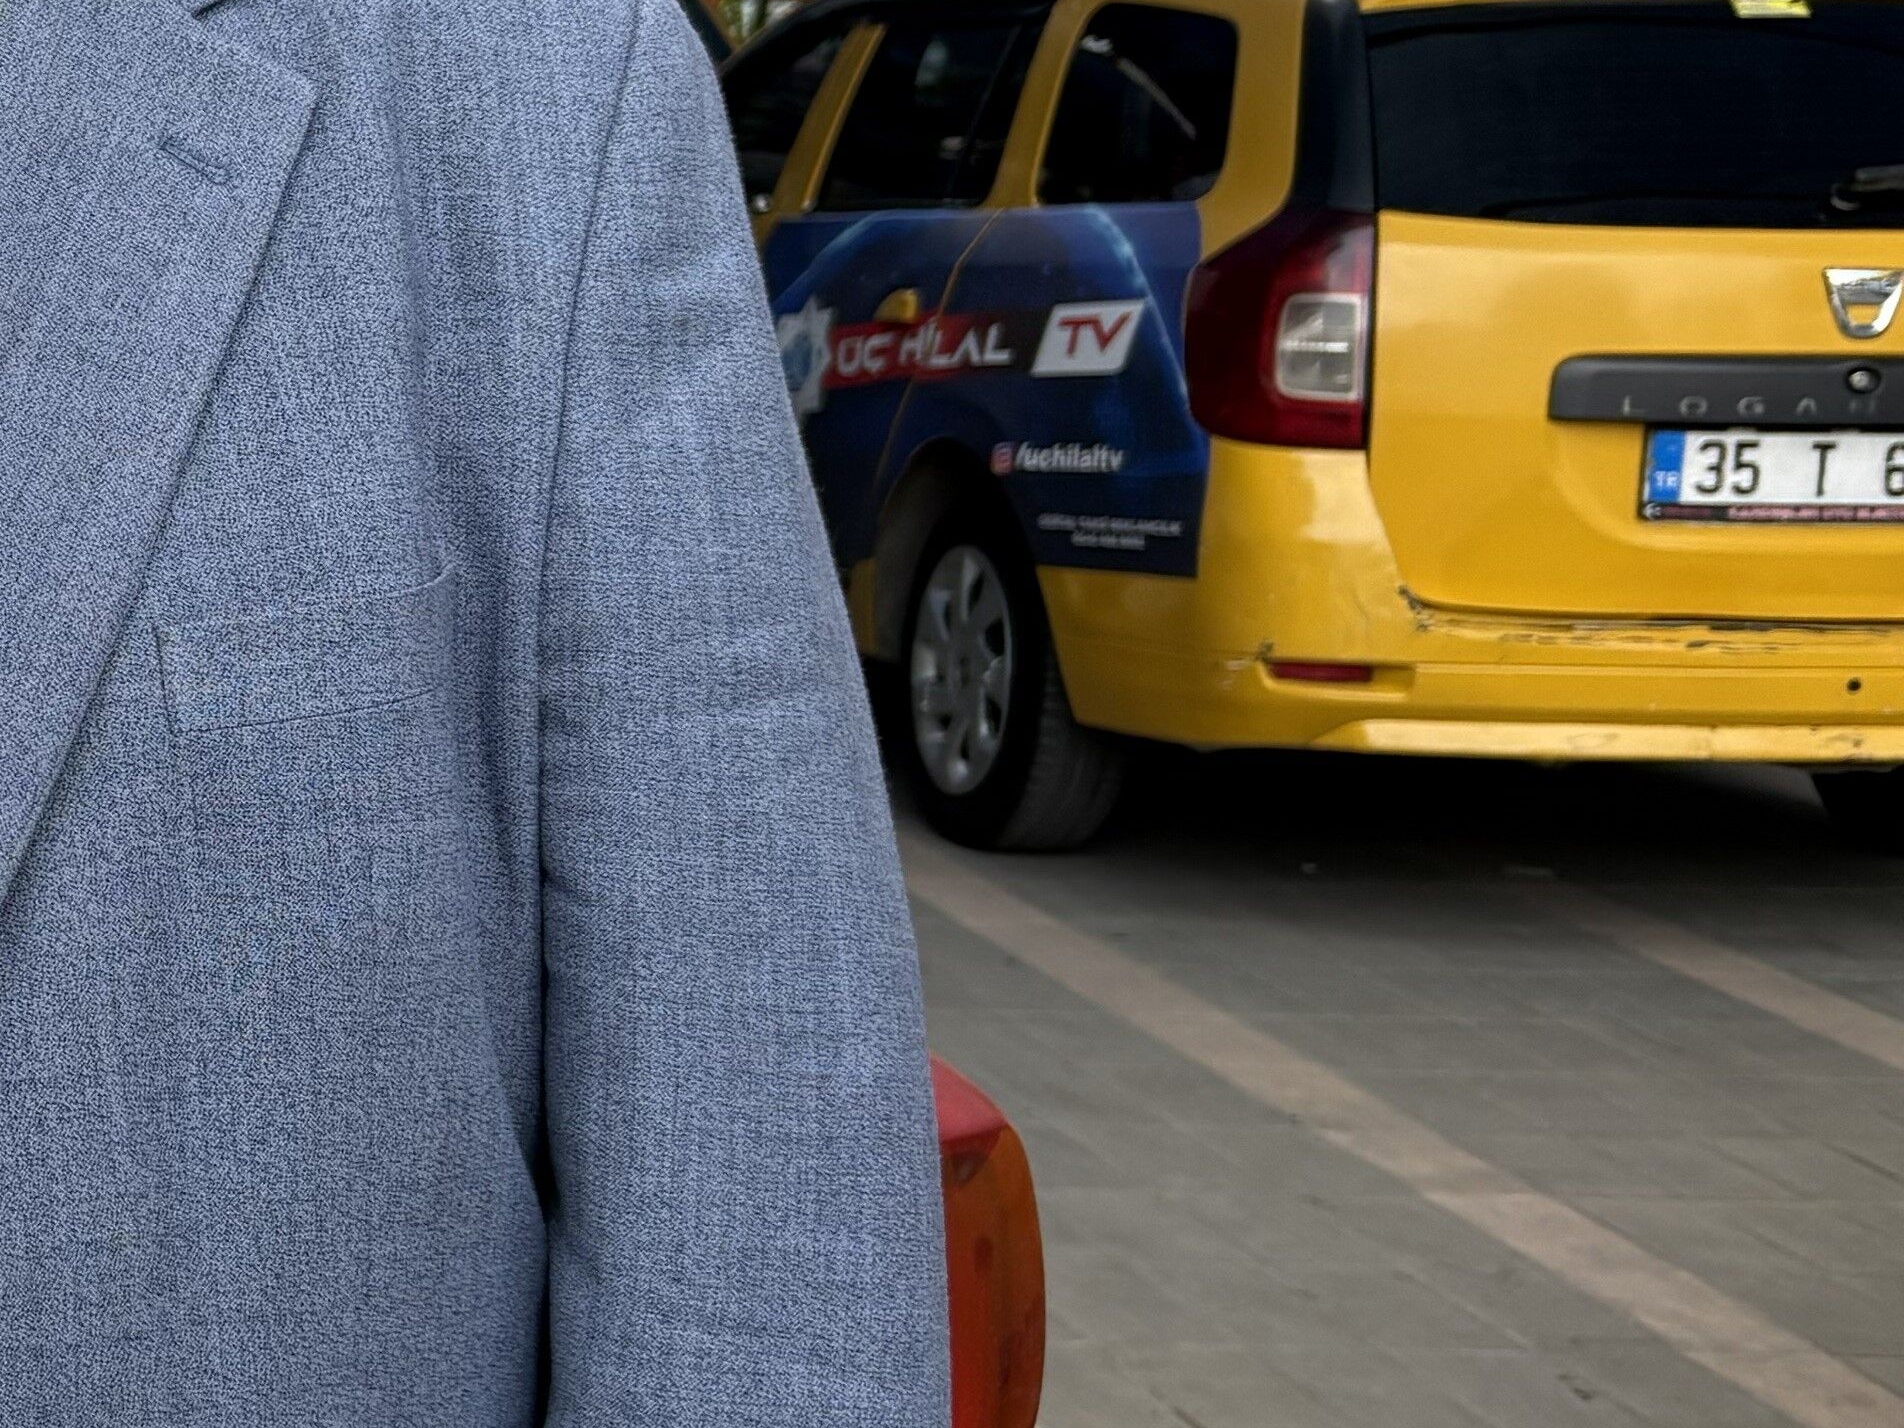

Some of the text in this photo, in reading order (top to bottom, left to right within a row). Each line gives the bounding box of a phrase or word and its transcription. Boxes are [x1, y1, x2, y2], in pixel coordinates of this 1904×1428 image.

[1056, 310, 1133, 359] TV
[1695, 438, 1761, 495] 35
[1812, 440, 1837, 498] T
